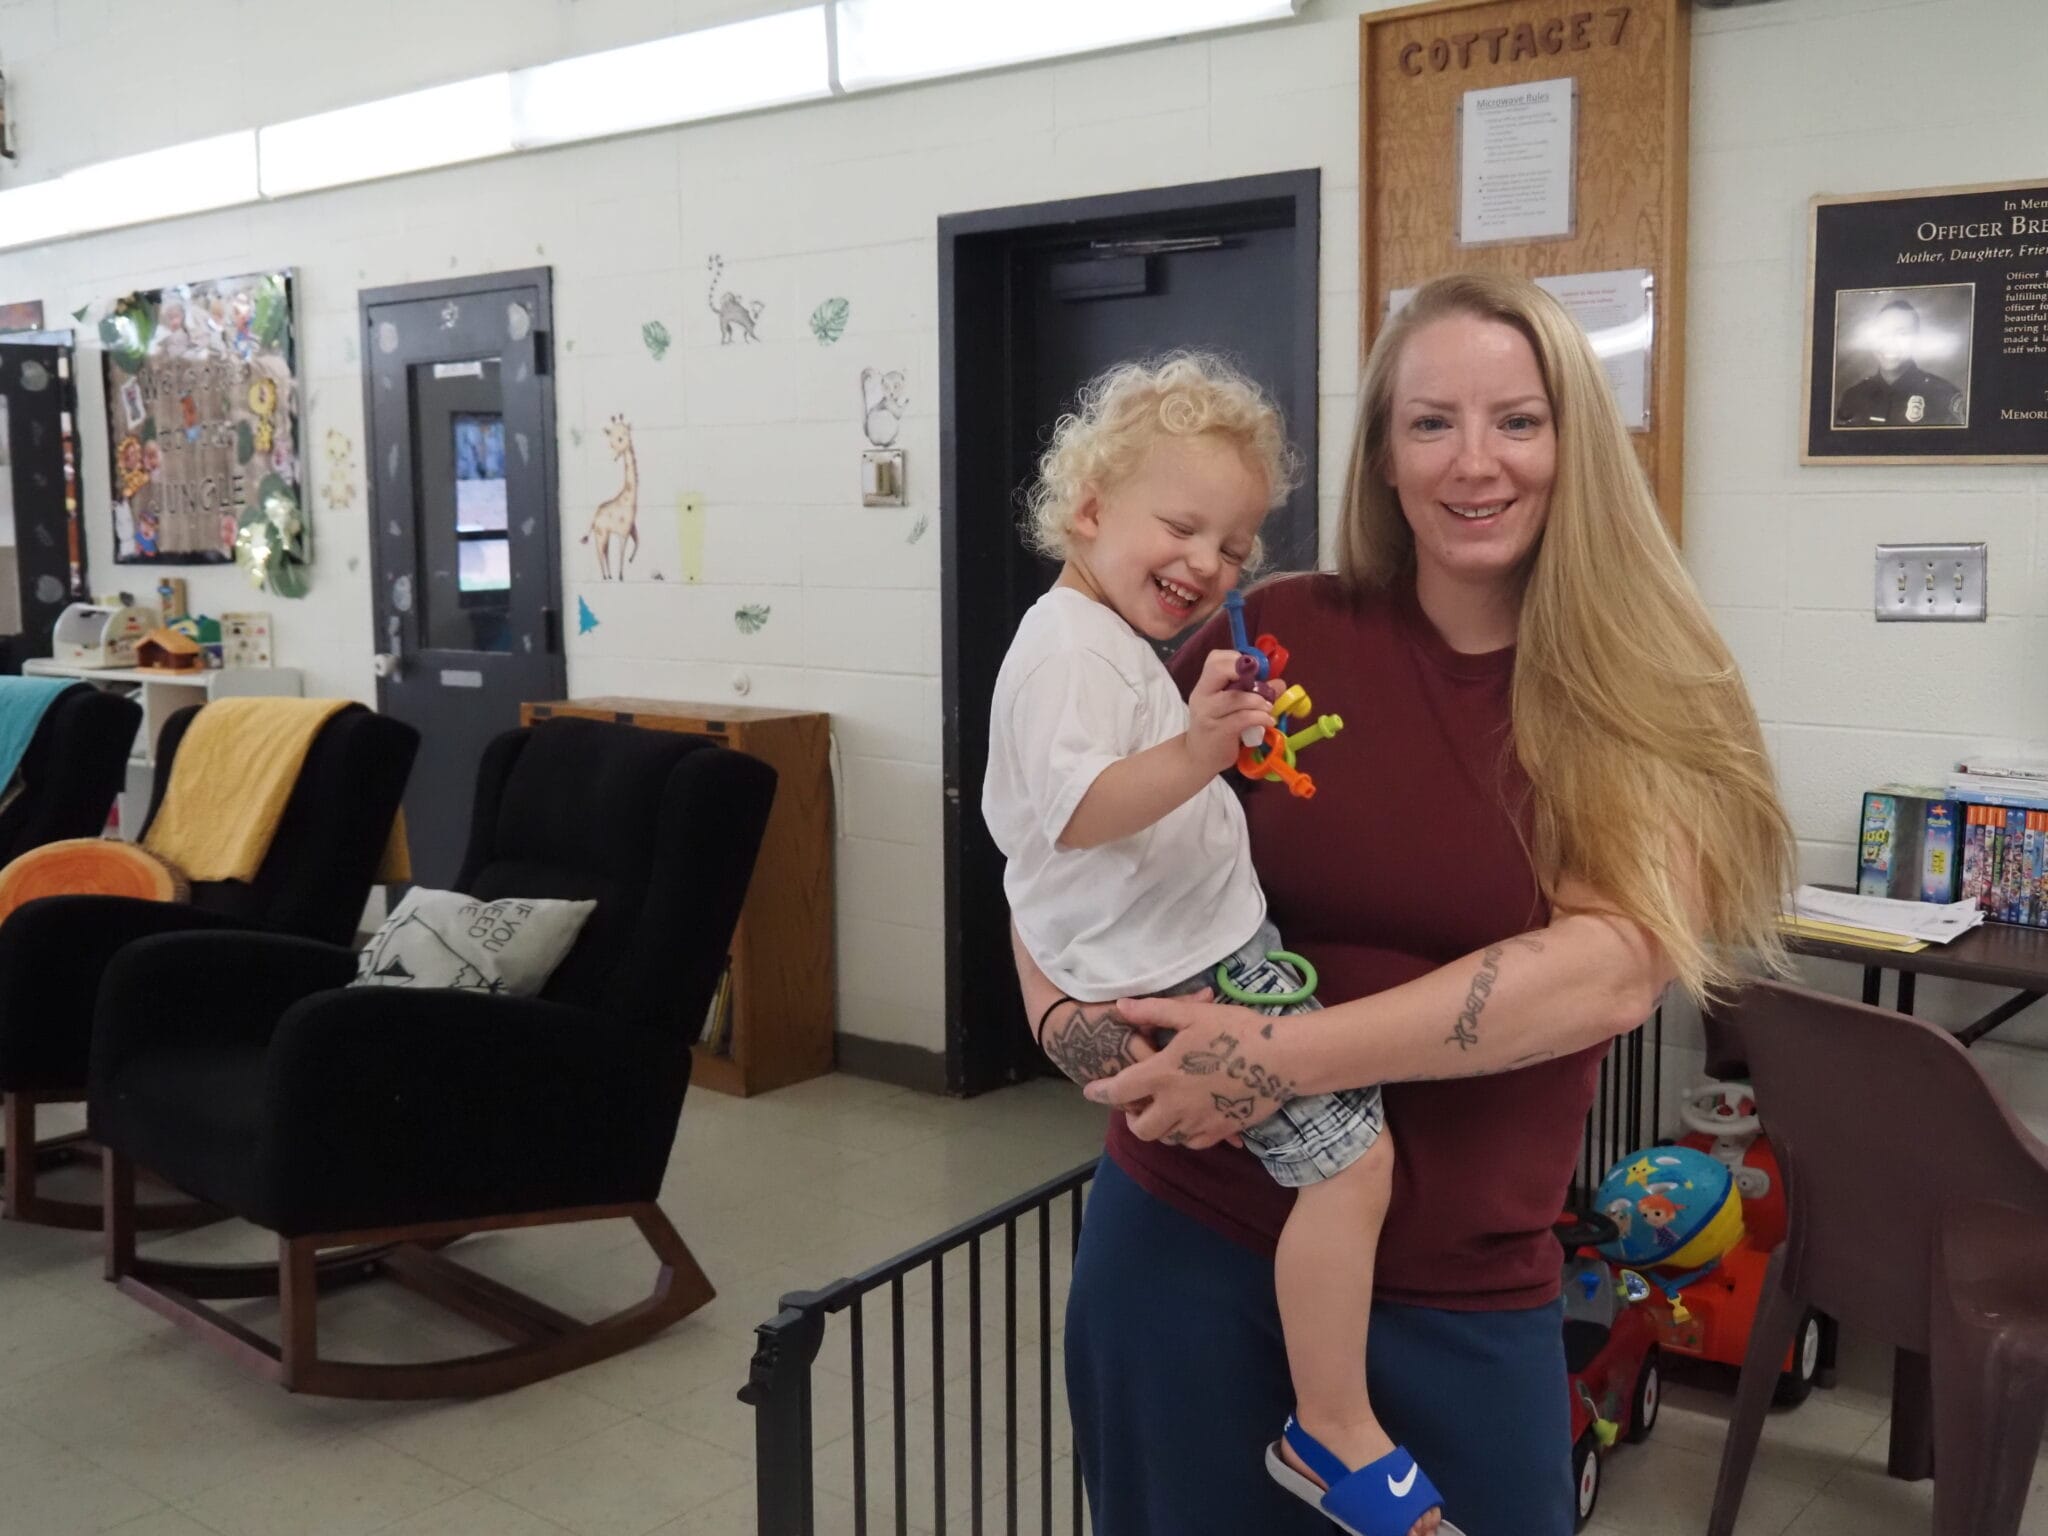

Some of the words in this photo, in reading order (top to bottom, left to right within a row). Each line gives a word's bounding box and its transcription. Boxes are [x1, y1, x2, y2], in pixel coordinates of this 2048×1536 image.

[1400, 12, 1592, 77] COTTAGE
[1605, 8, 1631, 46] 7
[1477, 96, 1523, 108] Microwave
[1526, 92, 1549, 104] Rules
[2004, 200, 2017, 211] In
[1917, 222, 2003, 241] OFFICER
[1896, 251, 1945, 264] Mother,
[1950, 247, 2014, 262] Daughter,
[2006, 272, 2039, 281] Officer
[2006, 293, 2048, 302] fulfilling
[2005, 303, 2035, 312] officer
[2004, 313, 2047, 322] beautiful
[2003, 324, 2039, 334] serving
[2003, 335, 2029, 343] made
[2002, 346, 2024, 354] staff
[2026, 344, 2047, 353] who
[152, 474, 245, 515] JUNGLE
[482, 919, 522, 953] YOU
